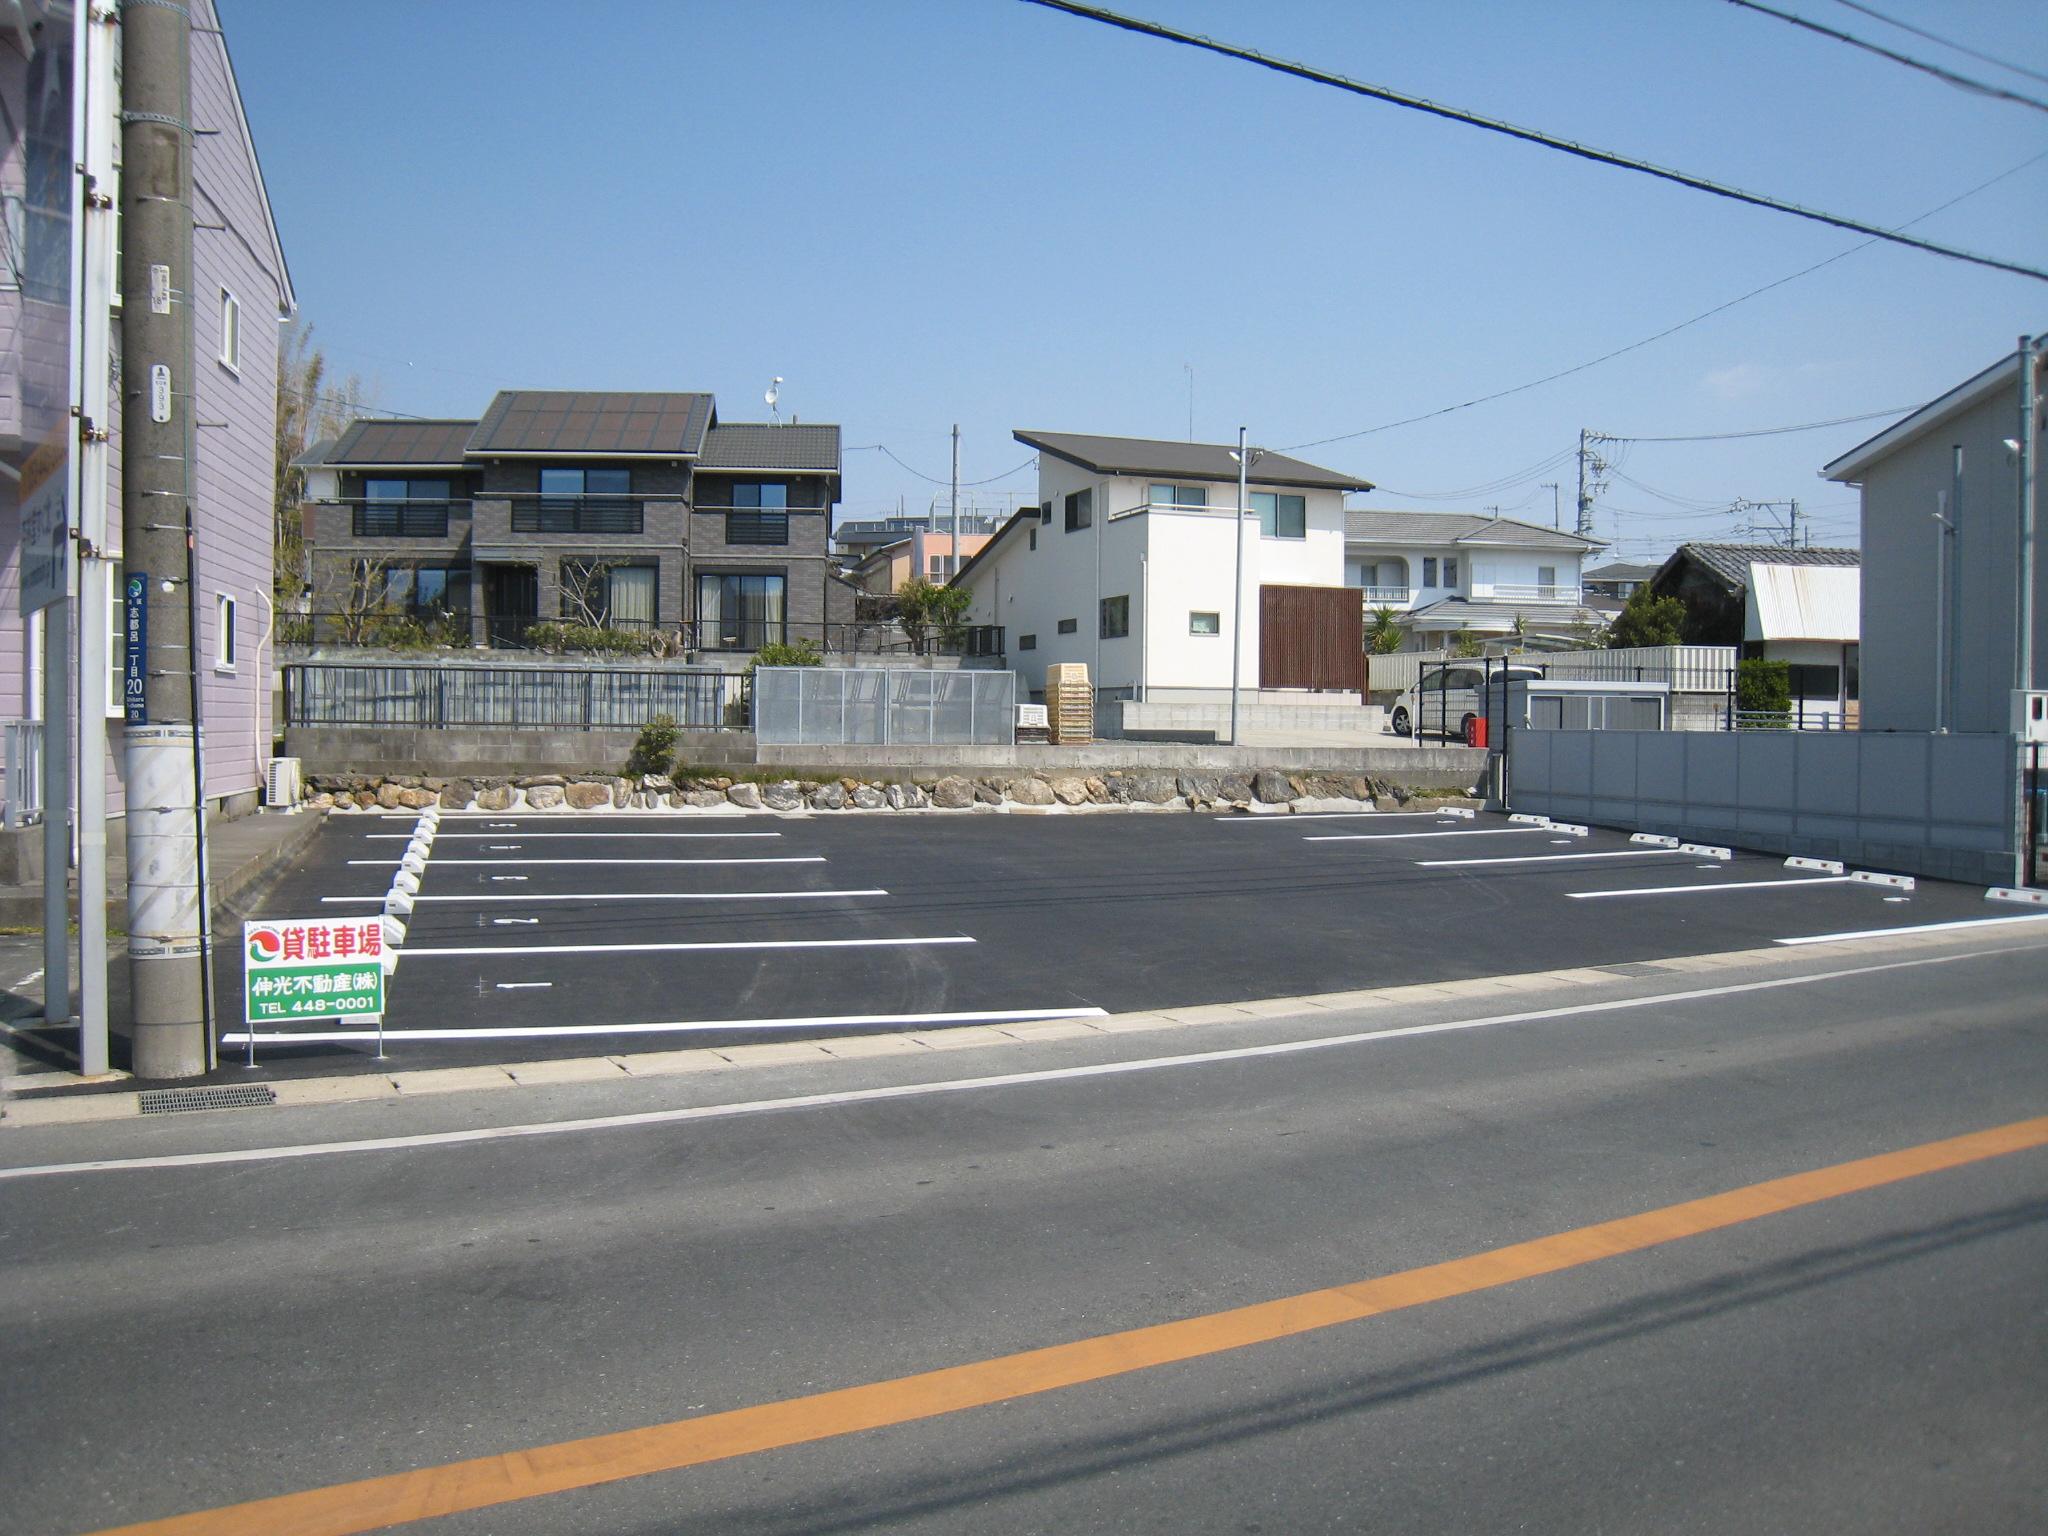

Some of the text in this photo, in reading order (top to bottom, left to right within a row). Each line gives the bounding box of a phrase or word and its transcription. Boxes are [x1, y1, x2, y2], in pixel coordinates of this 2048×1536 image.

[126, 678, 143, 695] 20
[281, 923, 381, 961] 貸駐車場
[252, 971, 378, 997] 伸光不動産(株)
[259, 996, 374, 1014] TEL 448-0001
